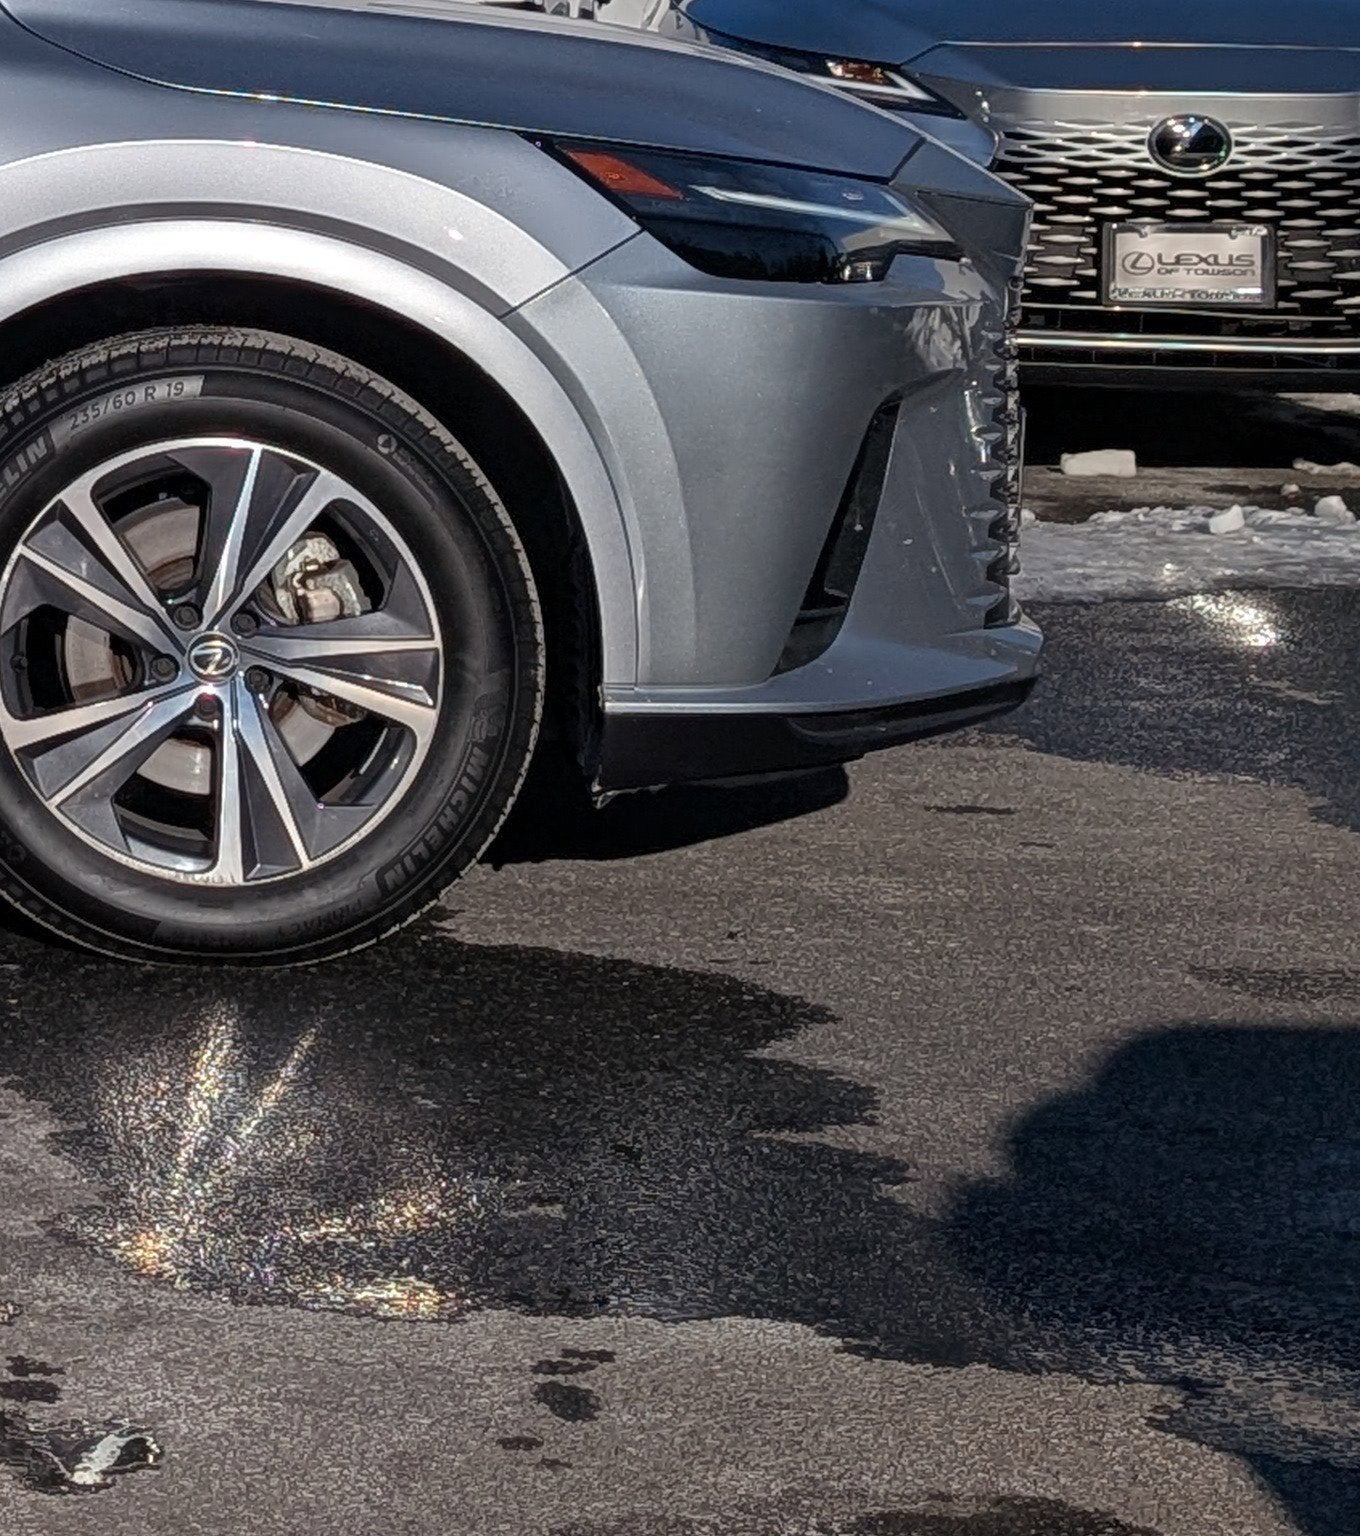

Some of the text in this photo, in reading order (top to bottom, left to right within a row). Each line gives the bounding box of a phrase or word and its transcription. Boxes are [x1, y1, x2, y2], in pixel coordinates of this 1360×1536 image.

[1157, 252, 1256, 267] LEXUS
[1157, 267, 1180, 276] OF
[69, 380, 185, 431] 235/60 R 19
[383, 745, 490, 893] MICHELIN
